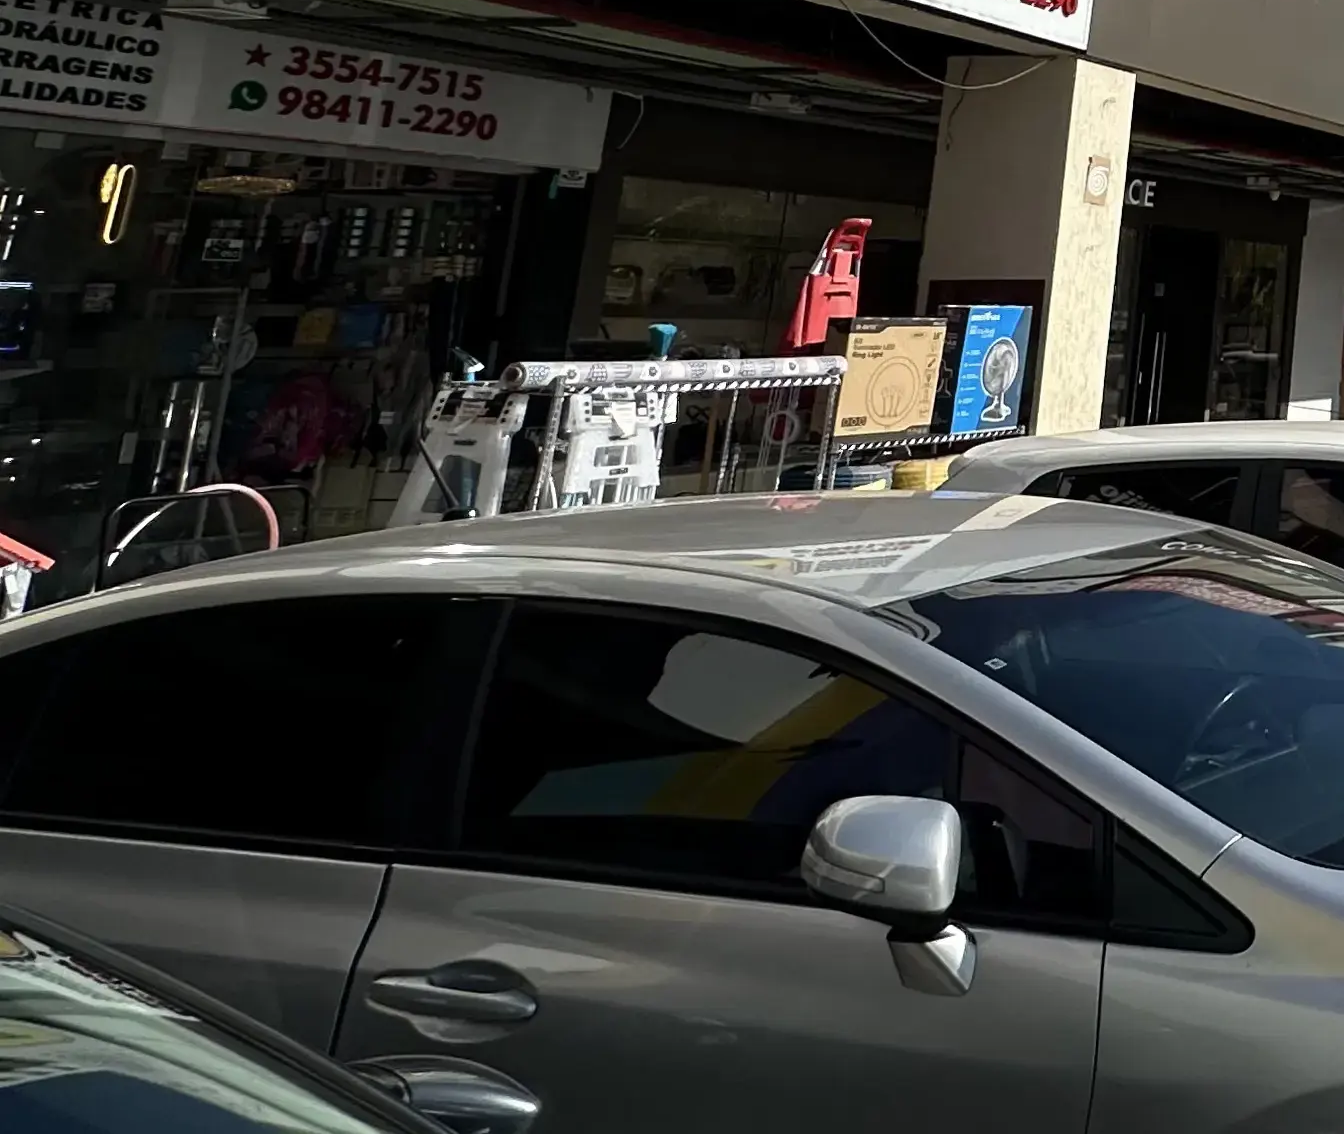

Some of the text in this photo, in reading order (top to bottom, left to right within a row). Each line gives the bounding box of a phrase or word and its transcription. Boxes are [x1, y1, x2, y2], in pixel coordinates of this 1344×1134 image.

[1, 79, 147, 112] LIDADES
[283, 46, 485, 102] 3554-7515
[277, 86, 498, 141] 98411-2290
